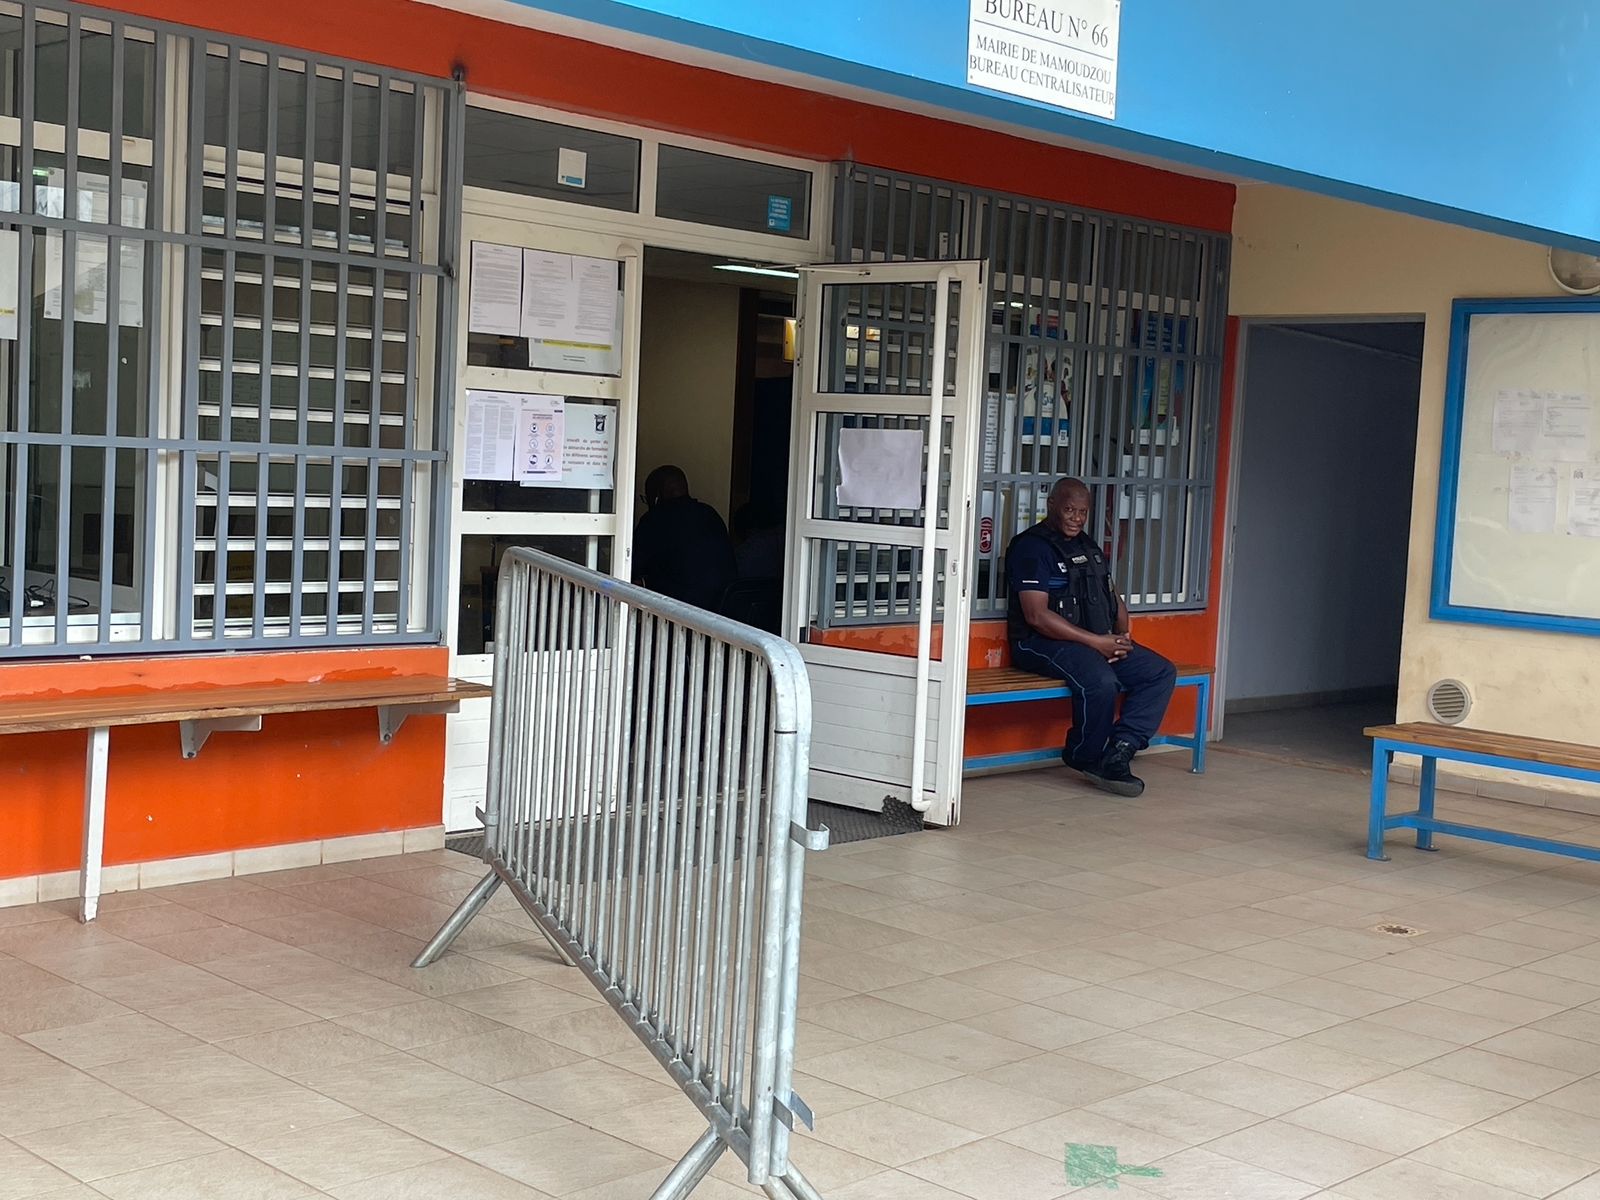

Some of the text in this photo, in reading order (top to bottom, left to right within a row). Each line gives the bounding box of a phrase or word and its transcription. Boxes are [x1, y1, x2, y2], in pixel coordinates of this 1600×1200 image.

[985, 0, 1109, 48] BUREAU N° 66
[969, 54, 1115, 105] BUREAU CENTRALISATEUR
[976, 34, 1112, 84] MAIRIE DE MAMOUDZOU
